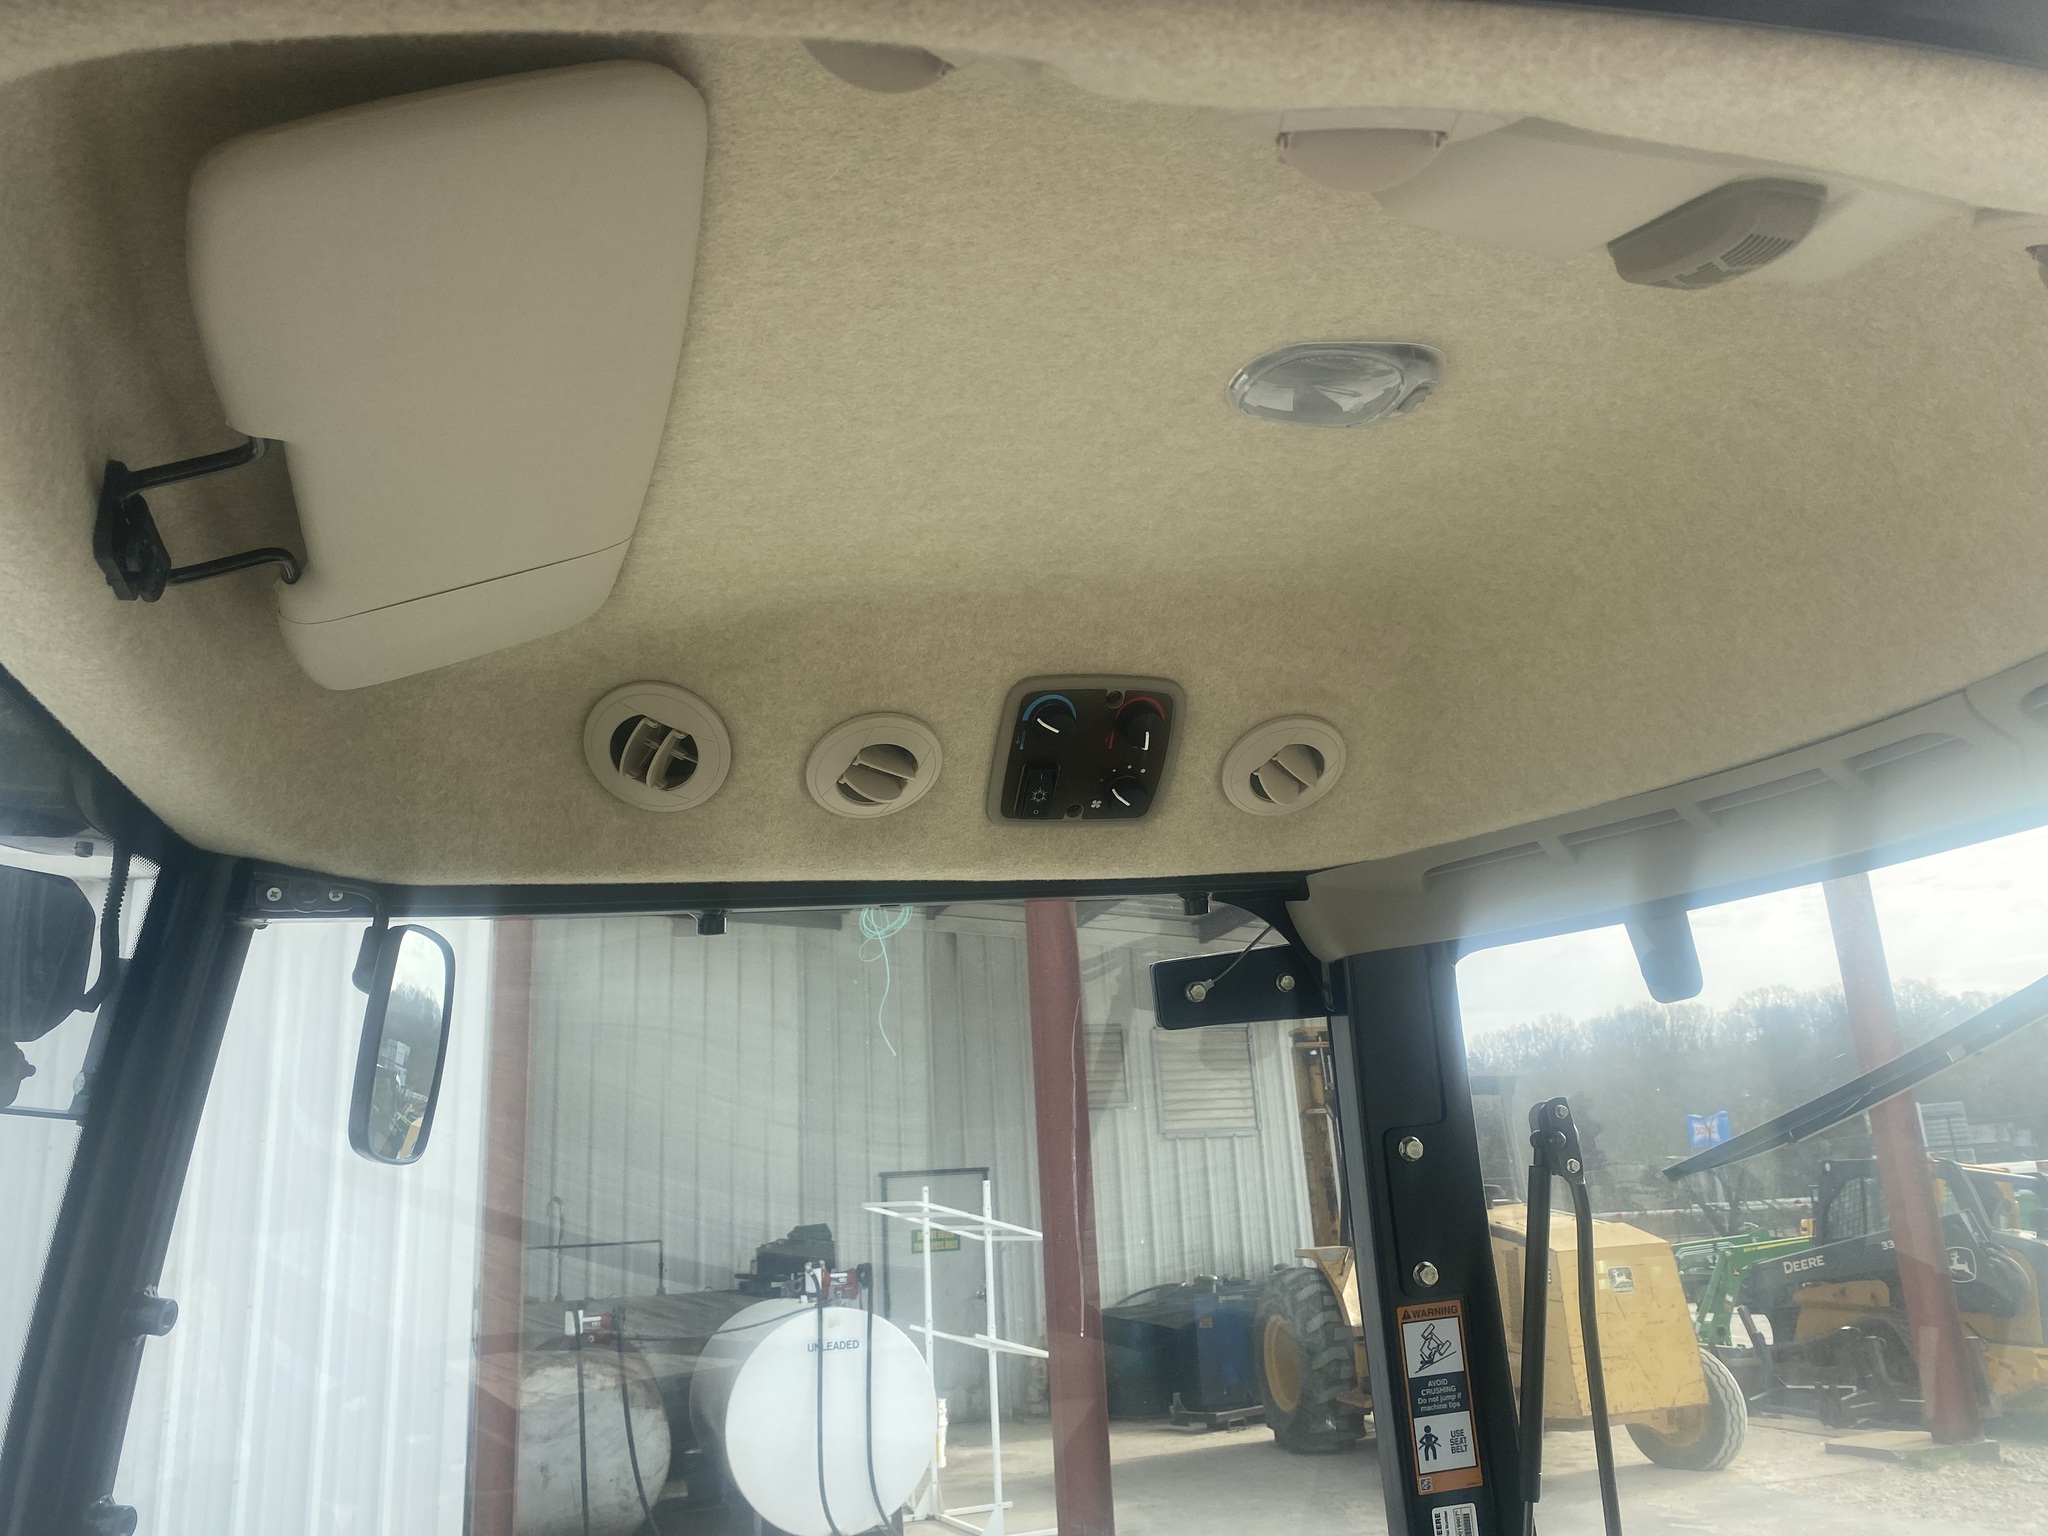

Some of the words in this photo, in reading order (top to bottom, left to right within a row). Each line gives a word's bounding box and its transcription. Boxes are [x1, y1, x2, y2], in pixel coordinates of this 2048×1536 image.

[1782, 1254, 1825, 1274] DEERE
[1411, 1305, 1458, 1319] WARNING
[1427, 1378, 1448, 1387] AVOID
[1420, 1385, 1457, 1396] CRUSHING
[1417, 1397, 1427, 1405] Do
[1440, 1394, 1456, 1403] jump
[1420, 1403, 1447, 1412] machine
[1448, 1401, 1460, 1409] tips
[1450, 1429, 1464, 1438] USE
[1449, 1437, 1467, 1446] SEAT
[1450, 1445, 1468, 1454] BELT
